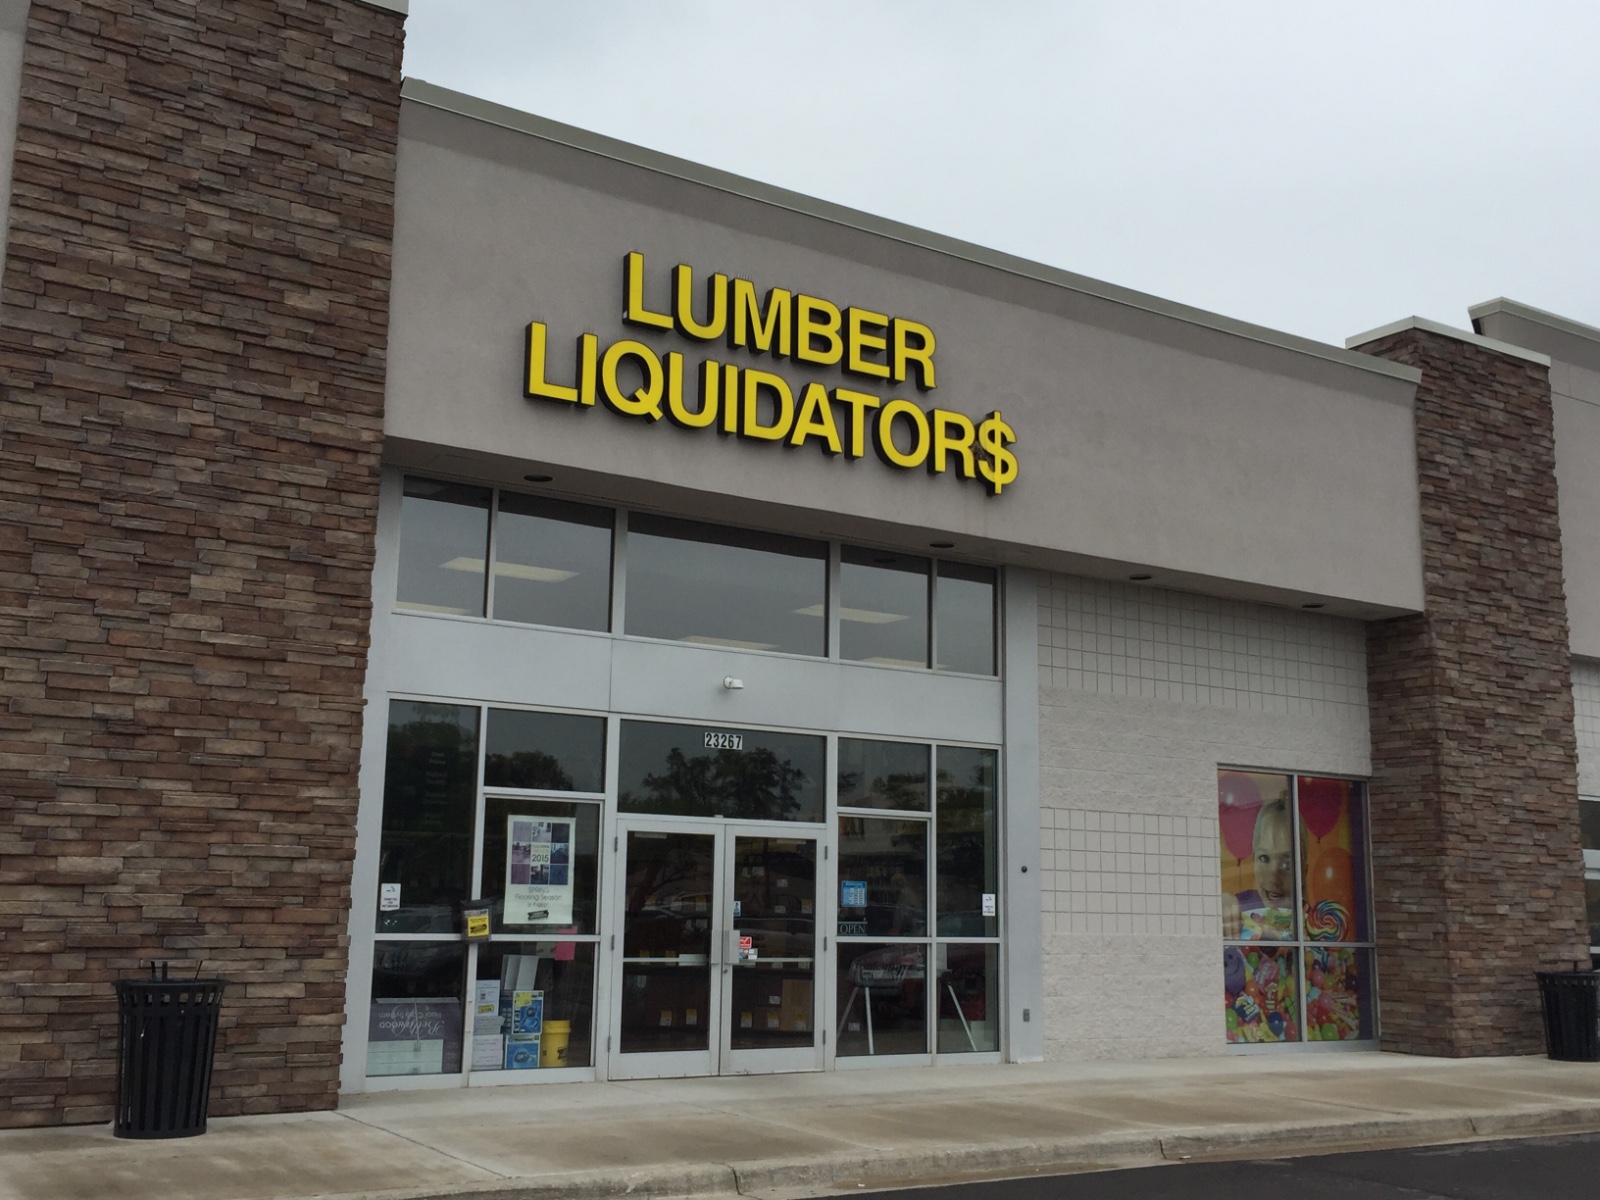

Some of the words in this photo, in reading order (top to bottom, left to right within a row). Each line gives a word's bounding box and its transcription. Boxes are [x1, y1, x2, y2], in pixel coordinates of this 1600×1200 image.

[623, 251, 937, 390] LUMBER
[705, 732, 742, 749] 23267
[531, 854, 549, 862] 2015
[840, 924, 866, 934] OPEN
